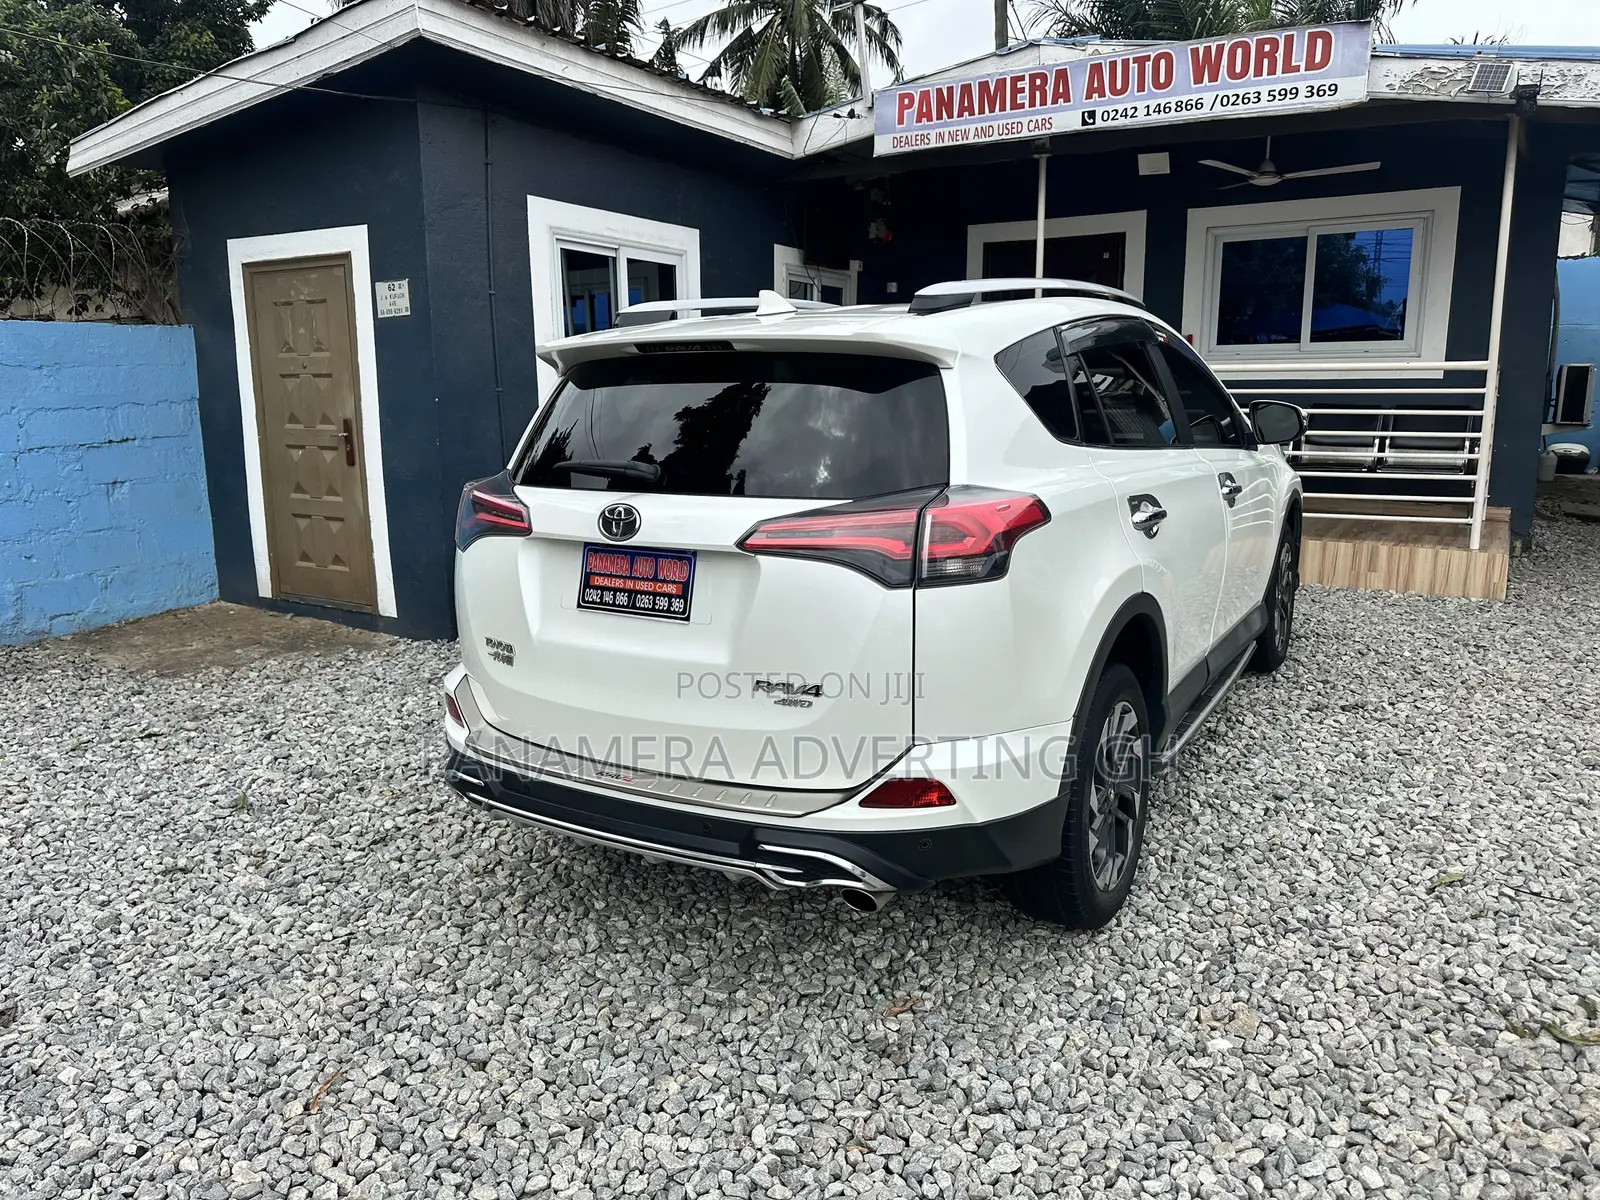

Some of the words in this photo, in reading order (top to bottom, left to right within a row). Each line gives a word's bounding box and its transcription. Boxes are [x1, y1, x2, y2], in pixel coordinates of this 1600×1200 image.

[896, 68, 1072, 126] PANAMERA
[1084, 51, 1174, 101] AUTO
[1189, 29, 1333, 86] WORLD
[1100, 106, 1139, 123] 0242
[1266, 85, 1299, 102] 599
[1304, 82, 1339, 99] 369
[892, 132, 931, 149] DEALERS
[935, 129, 945, 144] IN
[947, 127, 970, 142] NEW
[973, 124, 995, 140] AND
[997, 121, 1024, 136] USED
[1027, 117, 1053, 133] CARS
[387, 283, 395, 291] 62
[587, 552, 631, 576] PANAMERA
[632, 556, 655, 579] AUTO
[657, 558, 689, 582] WORLD
[594, 577, 624, 588] DEALERS
[625, 579, 634, 589] IN
[635, 581, 655, 591] USED
[656, 583, 677, 593] CARS
[584, 588, 601, 602] 0242
[603, 590, 613, 604] 146
[615, 592, 628, 606] 866
[629, 593, 635, 607] /
[636, 594, 653, 608] 0263
[655, 596, 669, 610] 599
[670, 598, 684, 612] 369
[753, 680, 824, 697] RAV4
[774, 698, 813, 708] 4WD
